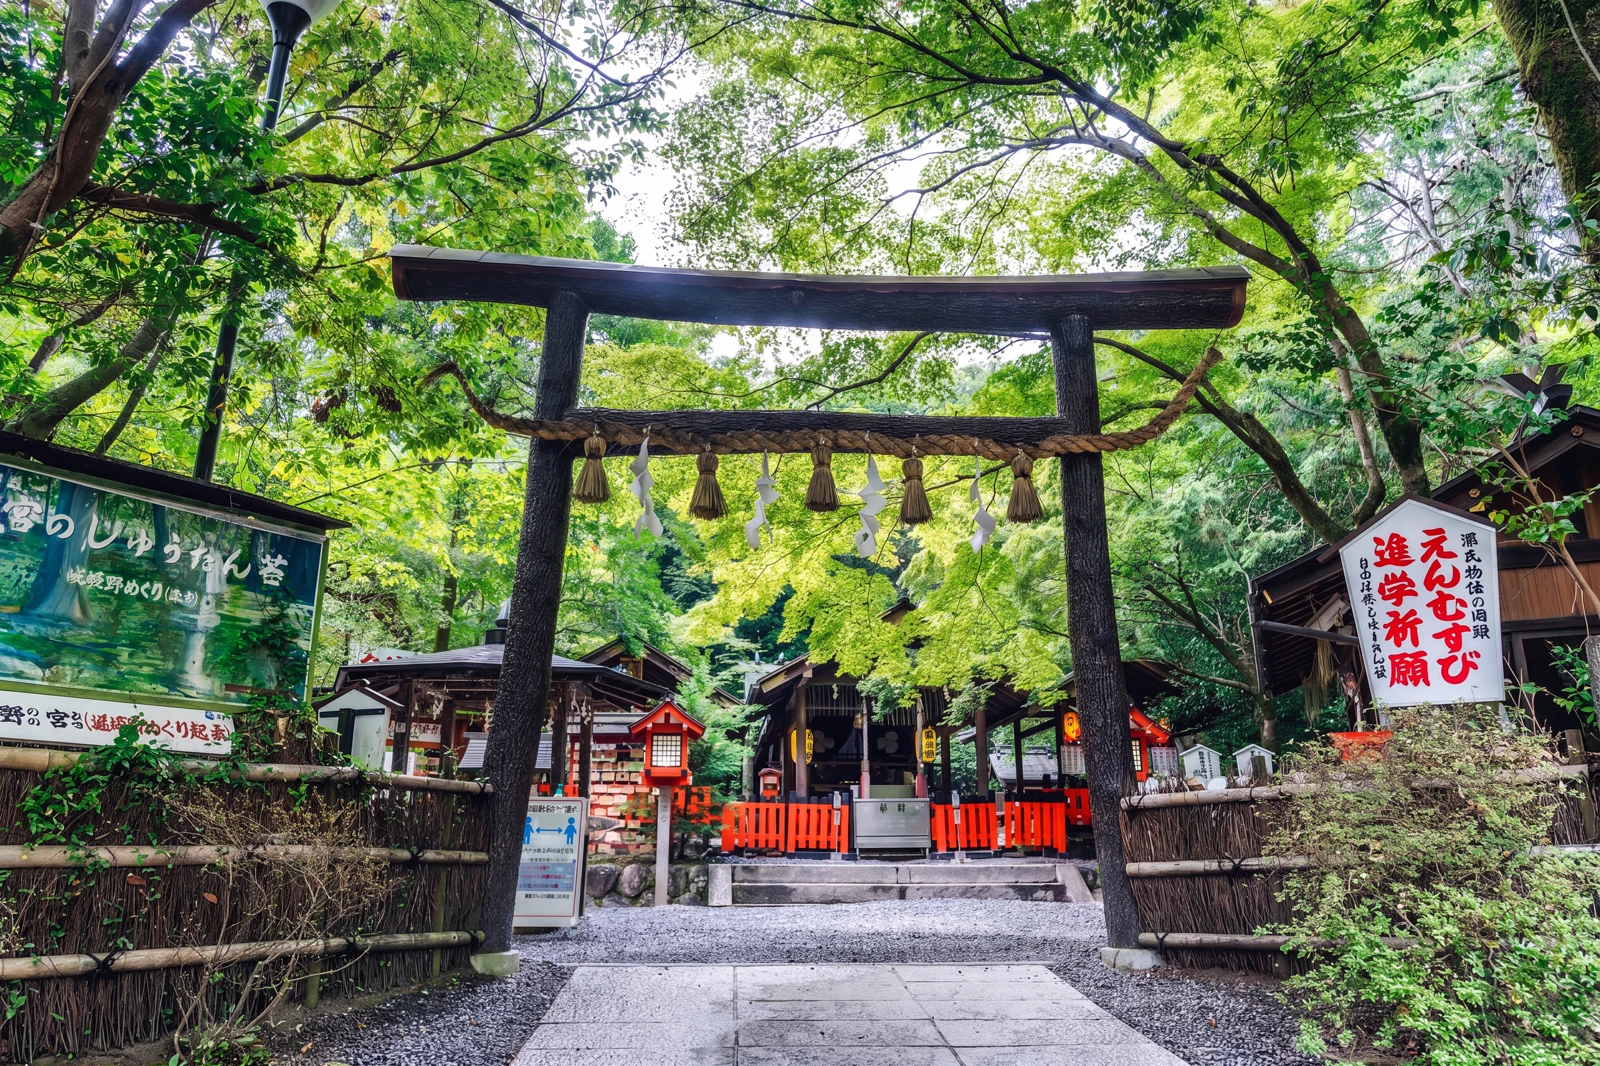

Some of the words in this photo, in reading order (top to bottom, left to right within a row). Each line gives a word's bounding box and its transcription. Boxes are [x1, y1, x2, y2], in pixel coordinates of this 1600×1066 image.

[1373, 532, 1430, 688] 進学祈願
[1421, 527, 1481, 685] えんむすび
